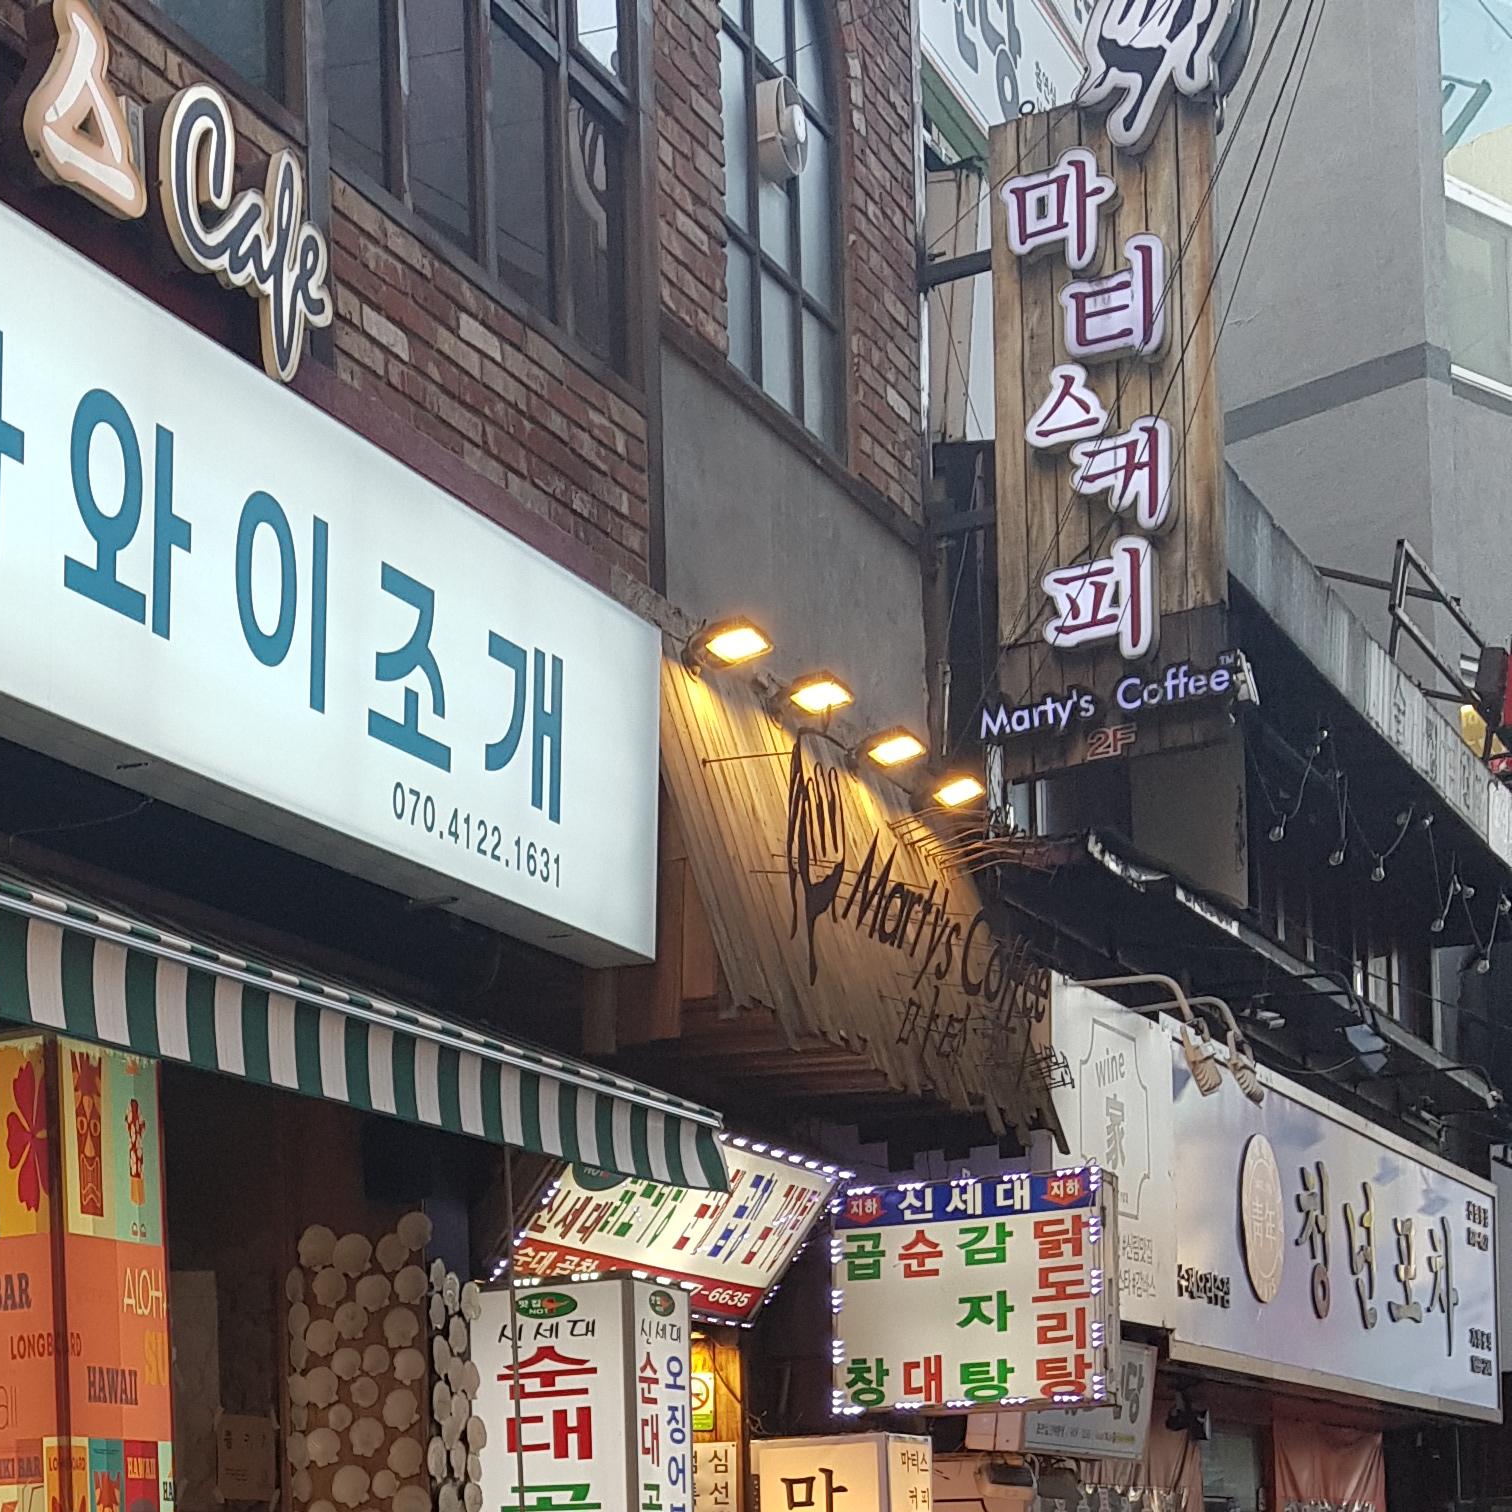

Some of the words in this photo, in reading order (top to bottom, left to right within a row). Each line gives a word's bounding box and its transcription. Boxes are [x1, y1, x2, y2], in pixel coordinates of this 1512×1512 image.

[159, 83, 333, 383] Cafe
[1002, 150, 1172, 657] 마티스커피
[979, 688, 1095, 740] Marty's
[1116, 664, 1230, 712] Coffee
[1088, 723, 1137, 758] 2F
[392, 781, 562, 889] 070.4122.1631
[841, 829, 962, 989] Marty's
[962, 906, 1051, 1034] Coffee
[1095, 1048, 1126, 1088] wine
[1105, 1093, 1126, 1169] 家
[850, 1198, 878, 1216] 지하
[898, 1178, 1031, 1221] 신세대
[1050, 1178, 1081, 1198] 지하
[1295, 1161, 1459, 1357] 청년포차
[123, 1267, 167, 1320] ALOH
[956, 1222, 1015, 1402] 감자탕
[1032, 1214, 1093, 1398] 닭도리탕
[10, 1332, 82, 1360] LONGBRD
[498, 1319, 596, 1350] 신세대
[640, 1317, 683, 1345] 신세대
[87, 1366, 138, 1405] HAWAII
[496, 1345, 598, 1460] 순대
[638, 1350, 661, 1468] 순대
[18, 1456, 42, 1479] BAR
[127, 1457, 157, 1479] HAWAII
[901, 1449, 930, 1475] 마티스
